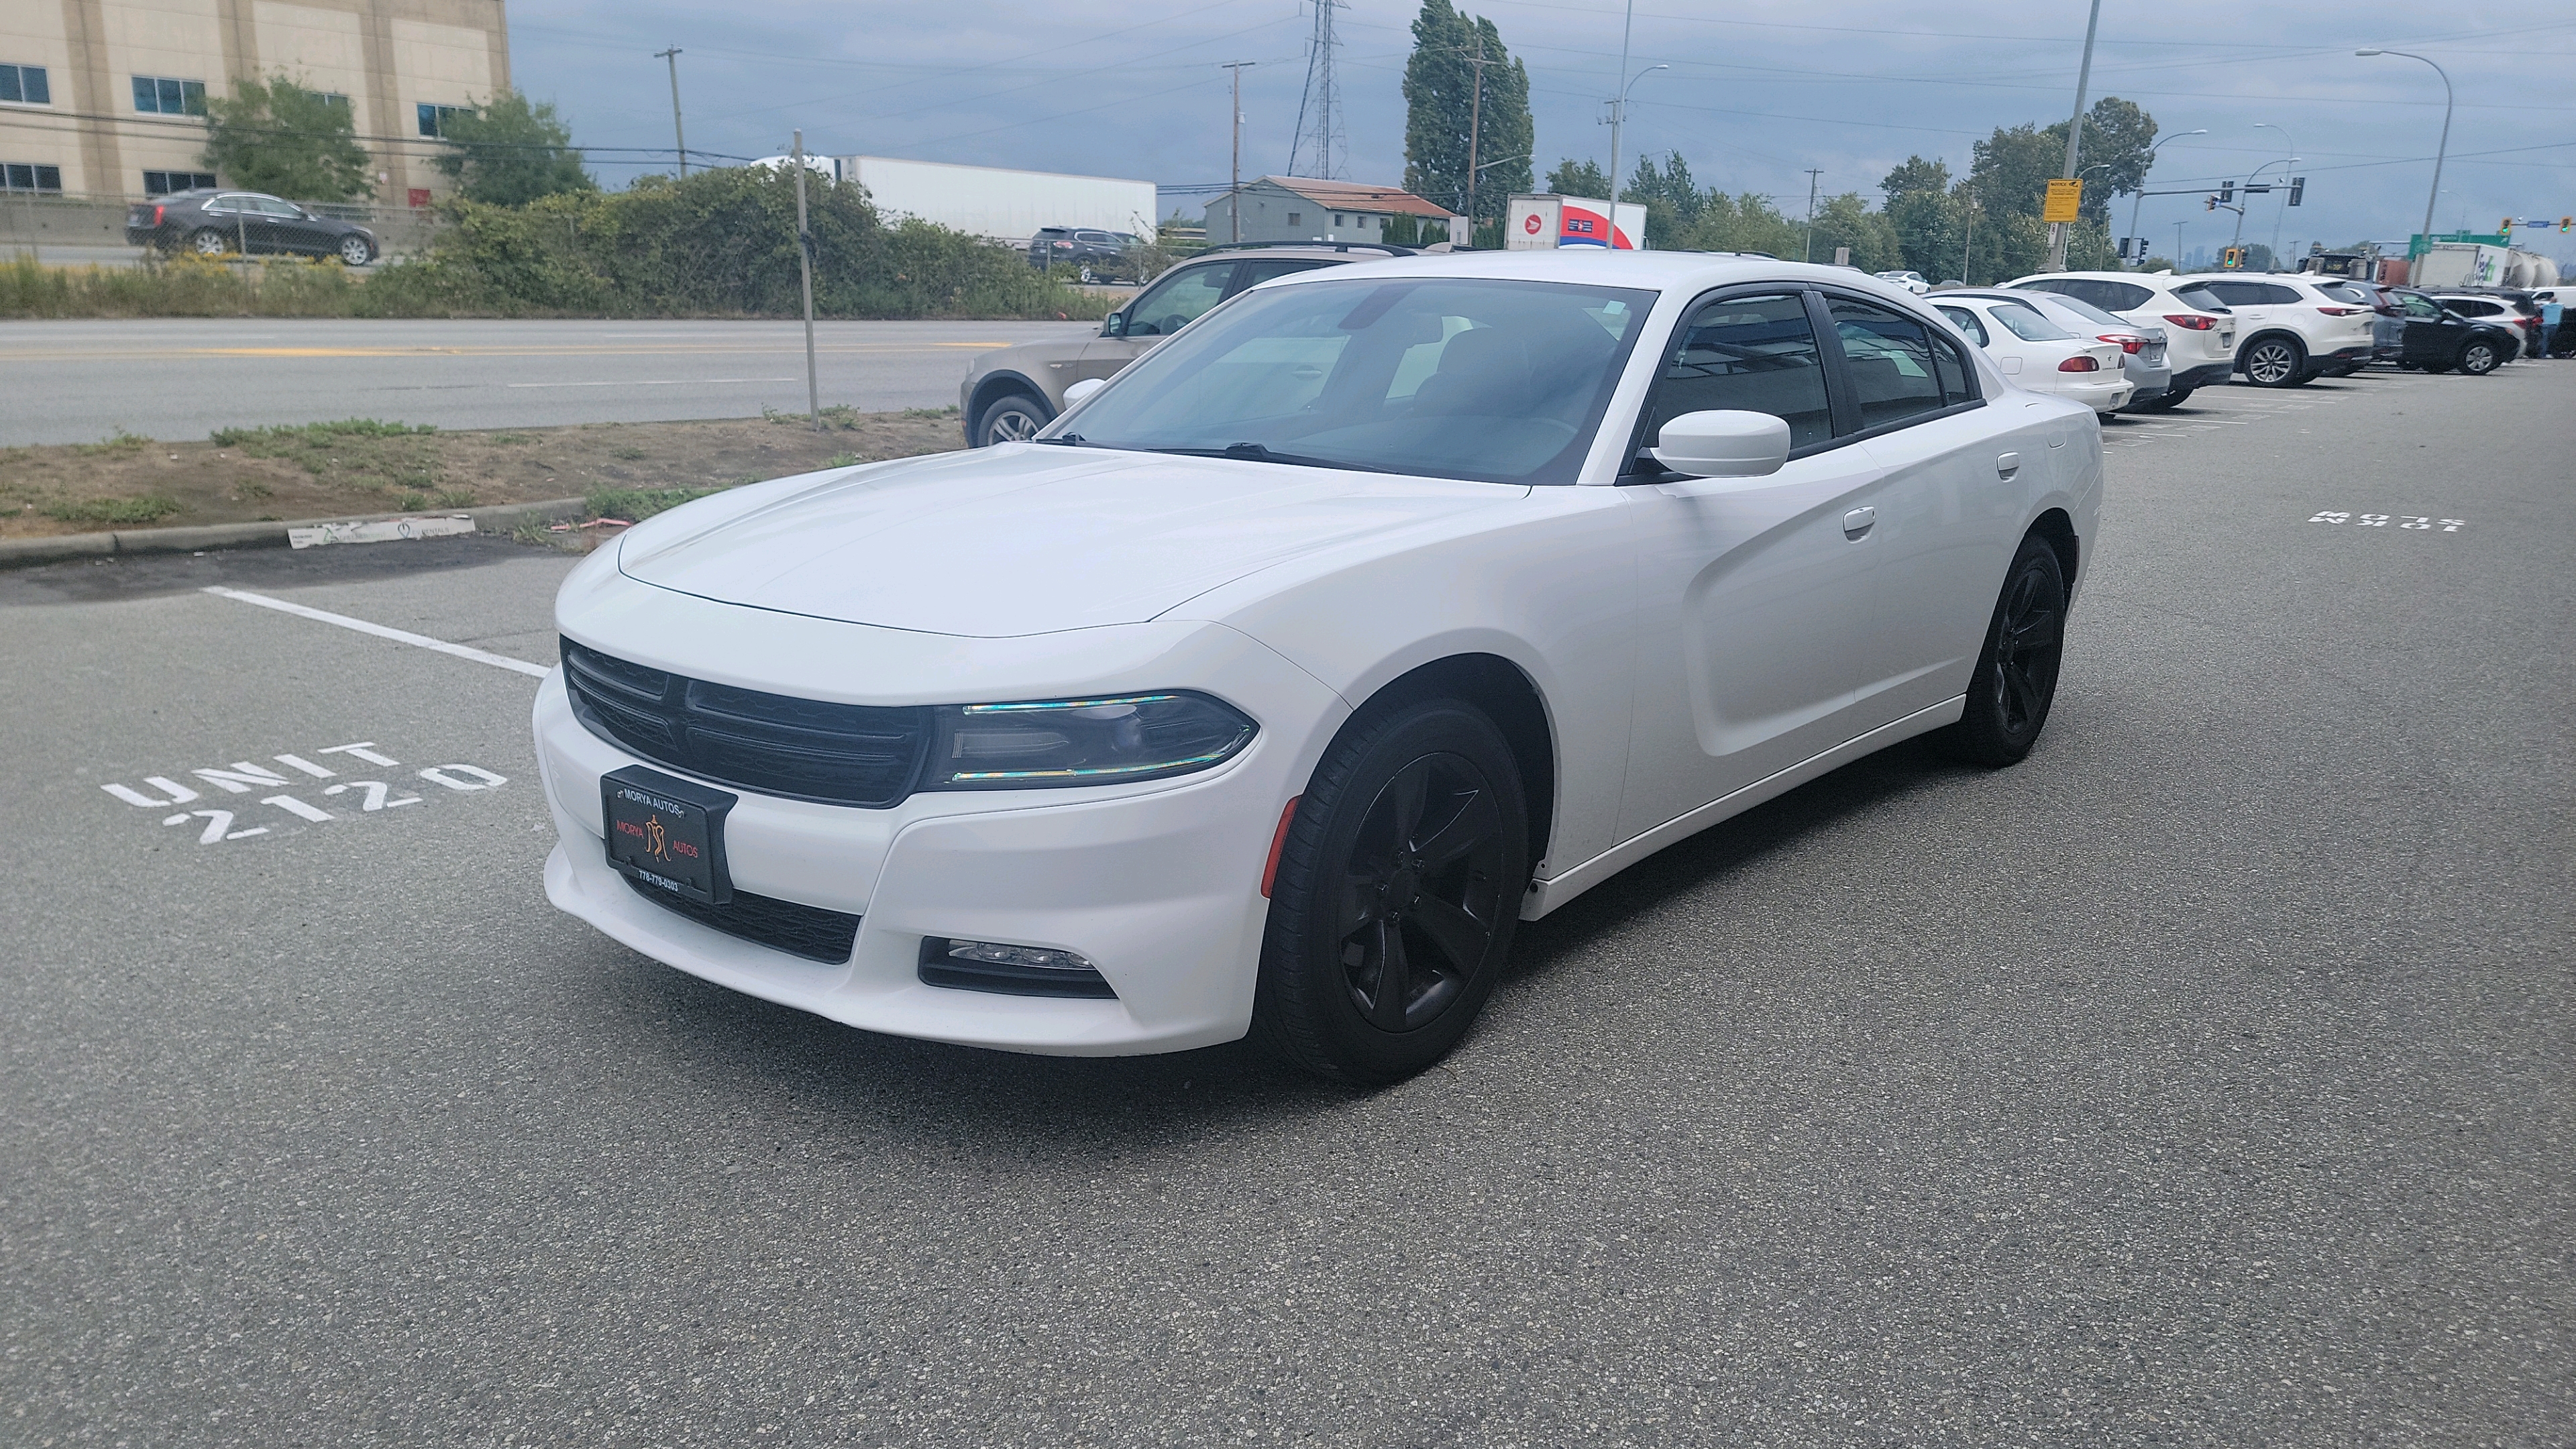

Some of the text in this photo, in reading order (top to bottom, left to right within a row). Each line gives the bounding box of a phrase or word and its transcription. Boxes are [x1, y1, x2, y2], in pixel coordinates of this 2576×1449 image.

[100, 741, 400, 808] UNIT
[162, 763, 508, 845] 2120
[624, 788, 680, 816] MORYA AUTOS
[616, 820, 698, 859] MORYA AUTOS
[639, 870, 678, 892] 778-779-0303
